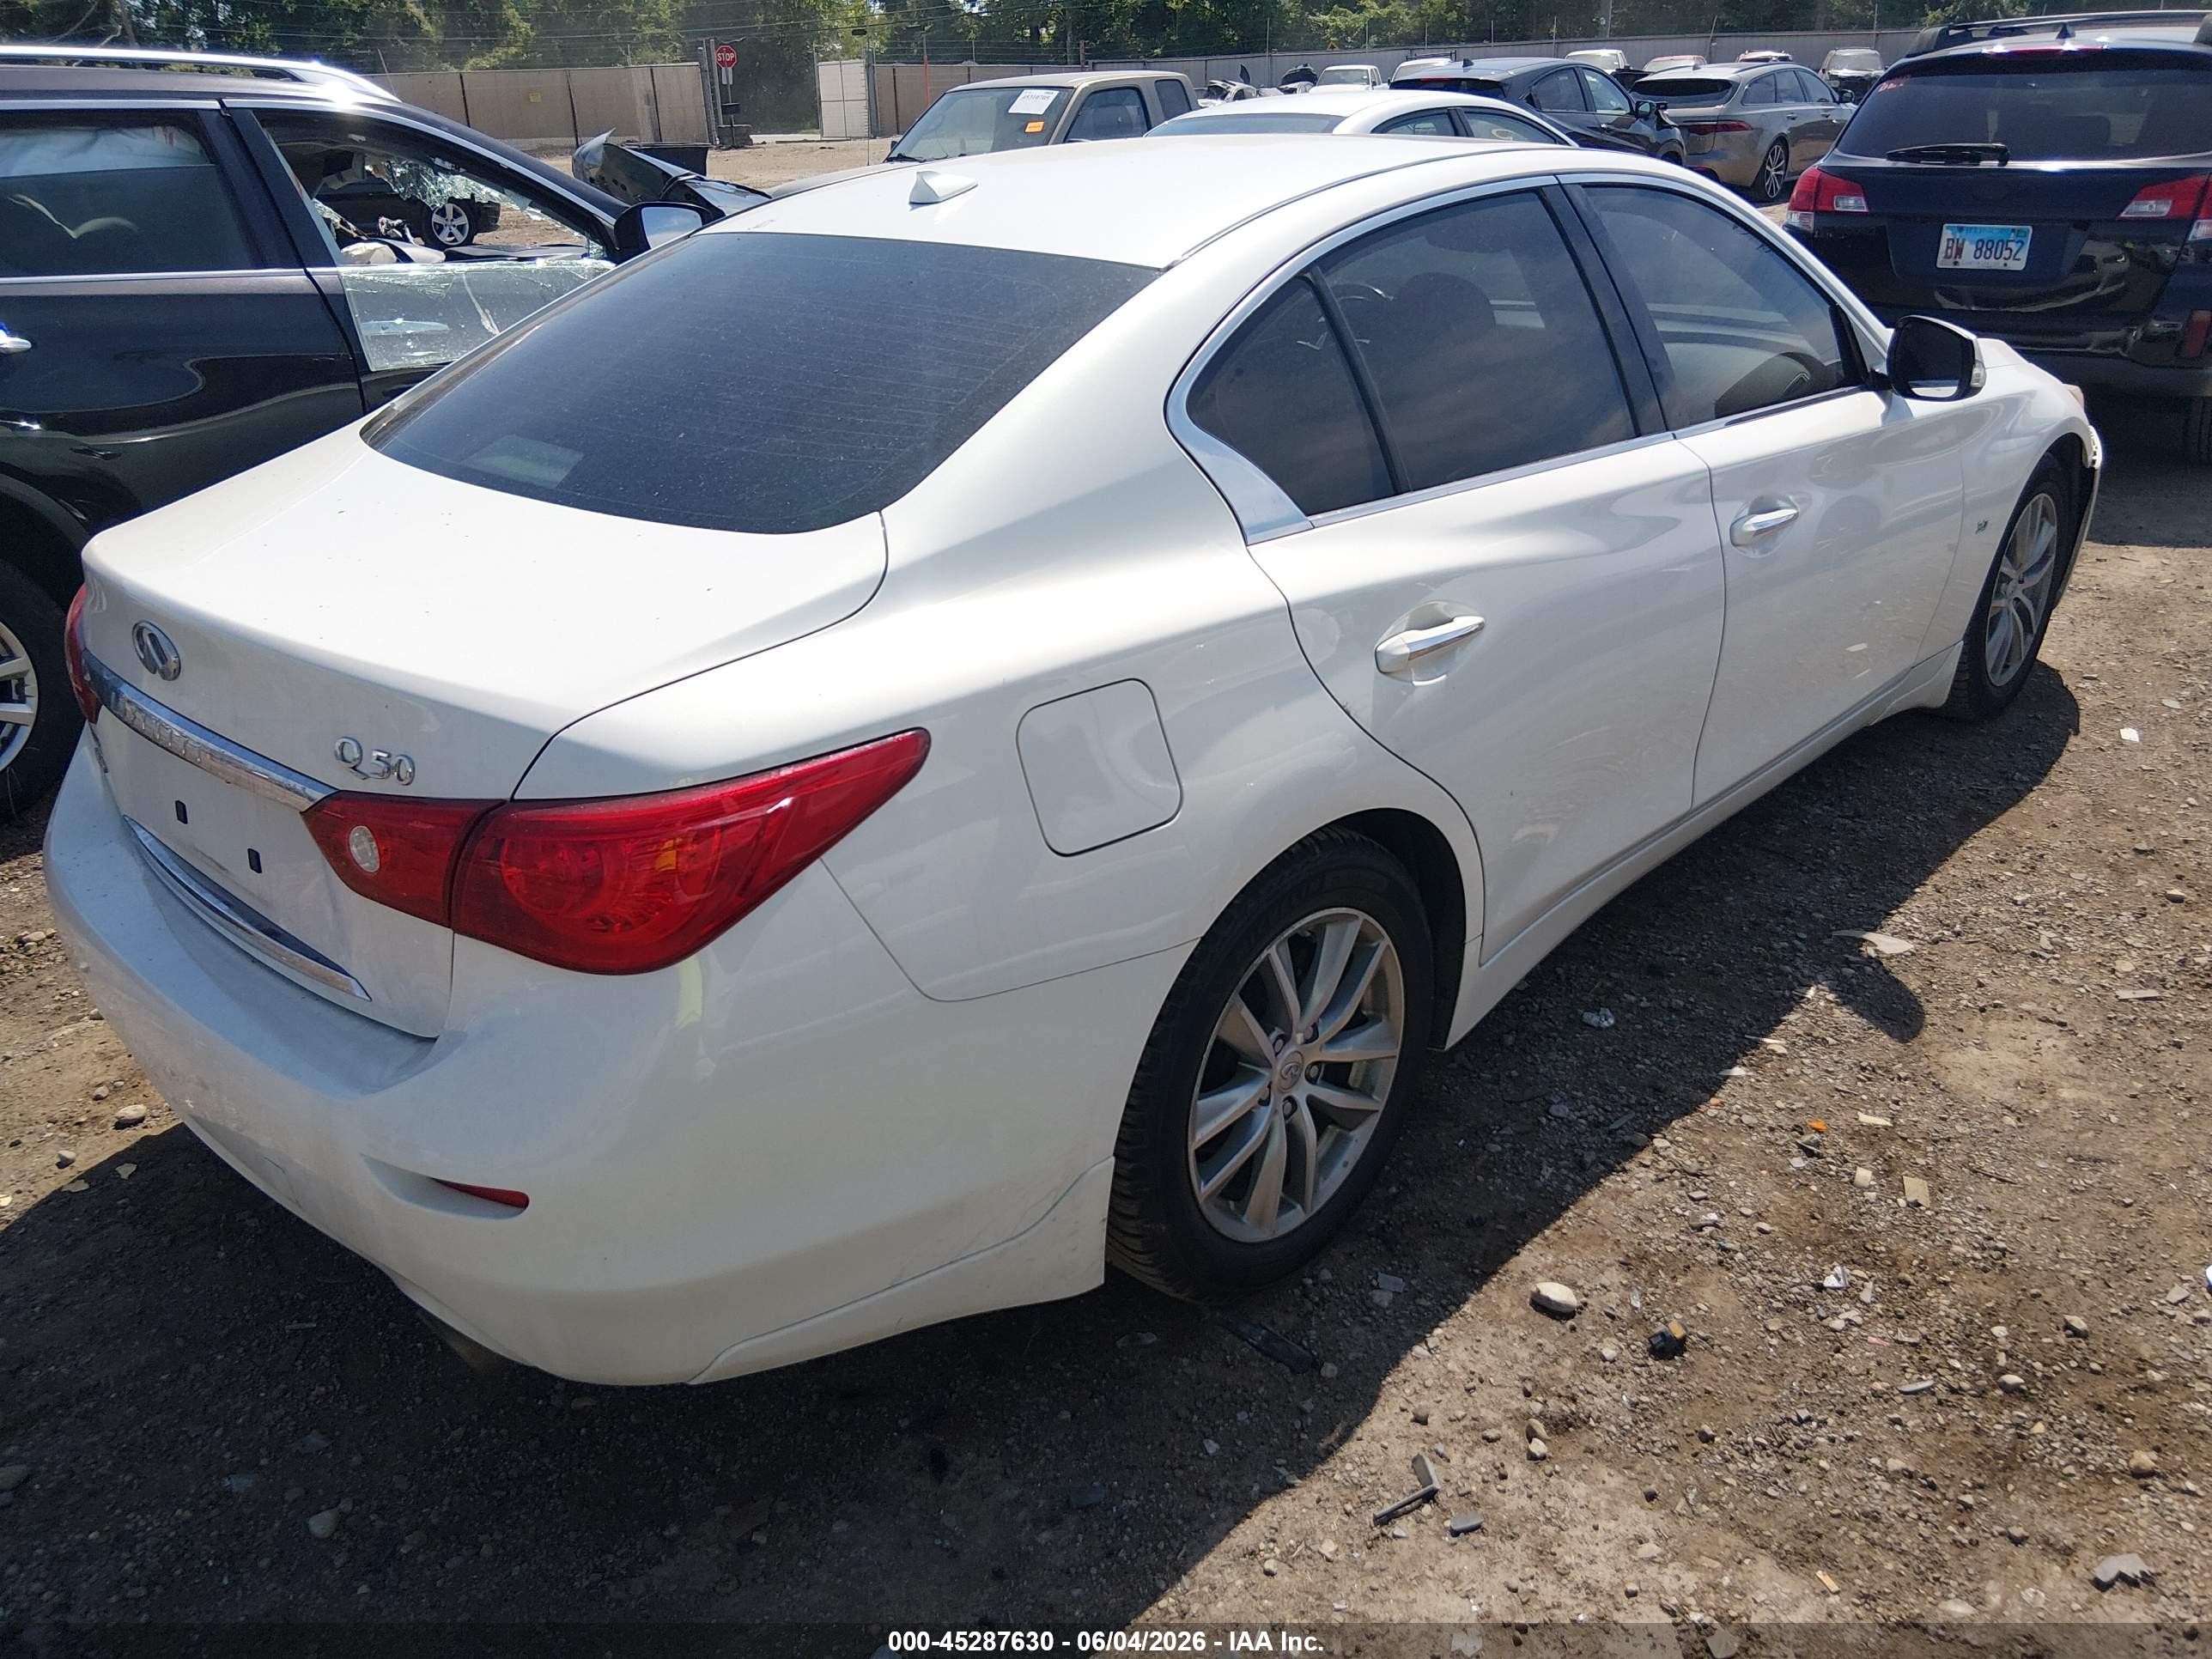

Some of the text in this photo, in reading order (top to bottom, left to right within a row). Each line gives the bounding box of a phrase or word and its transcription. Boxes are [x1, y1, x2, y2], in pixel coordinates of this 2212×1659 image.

[717, 52, 734, 61] STOP
[1942, 238, 2025, 262] BW 88052
[334, 736, 416, 786] Q50
